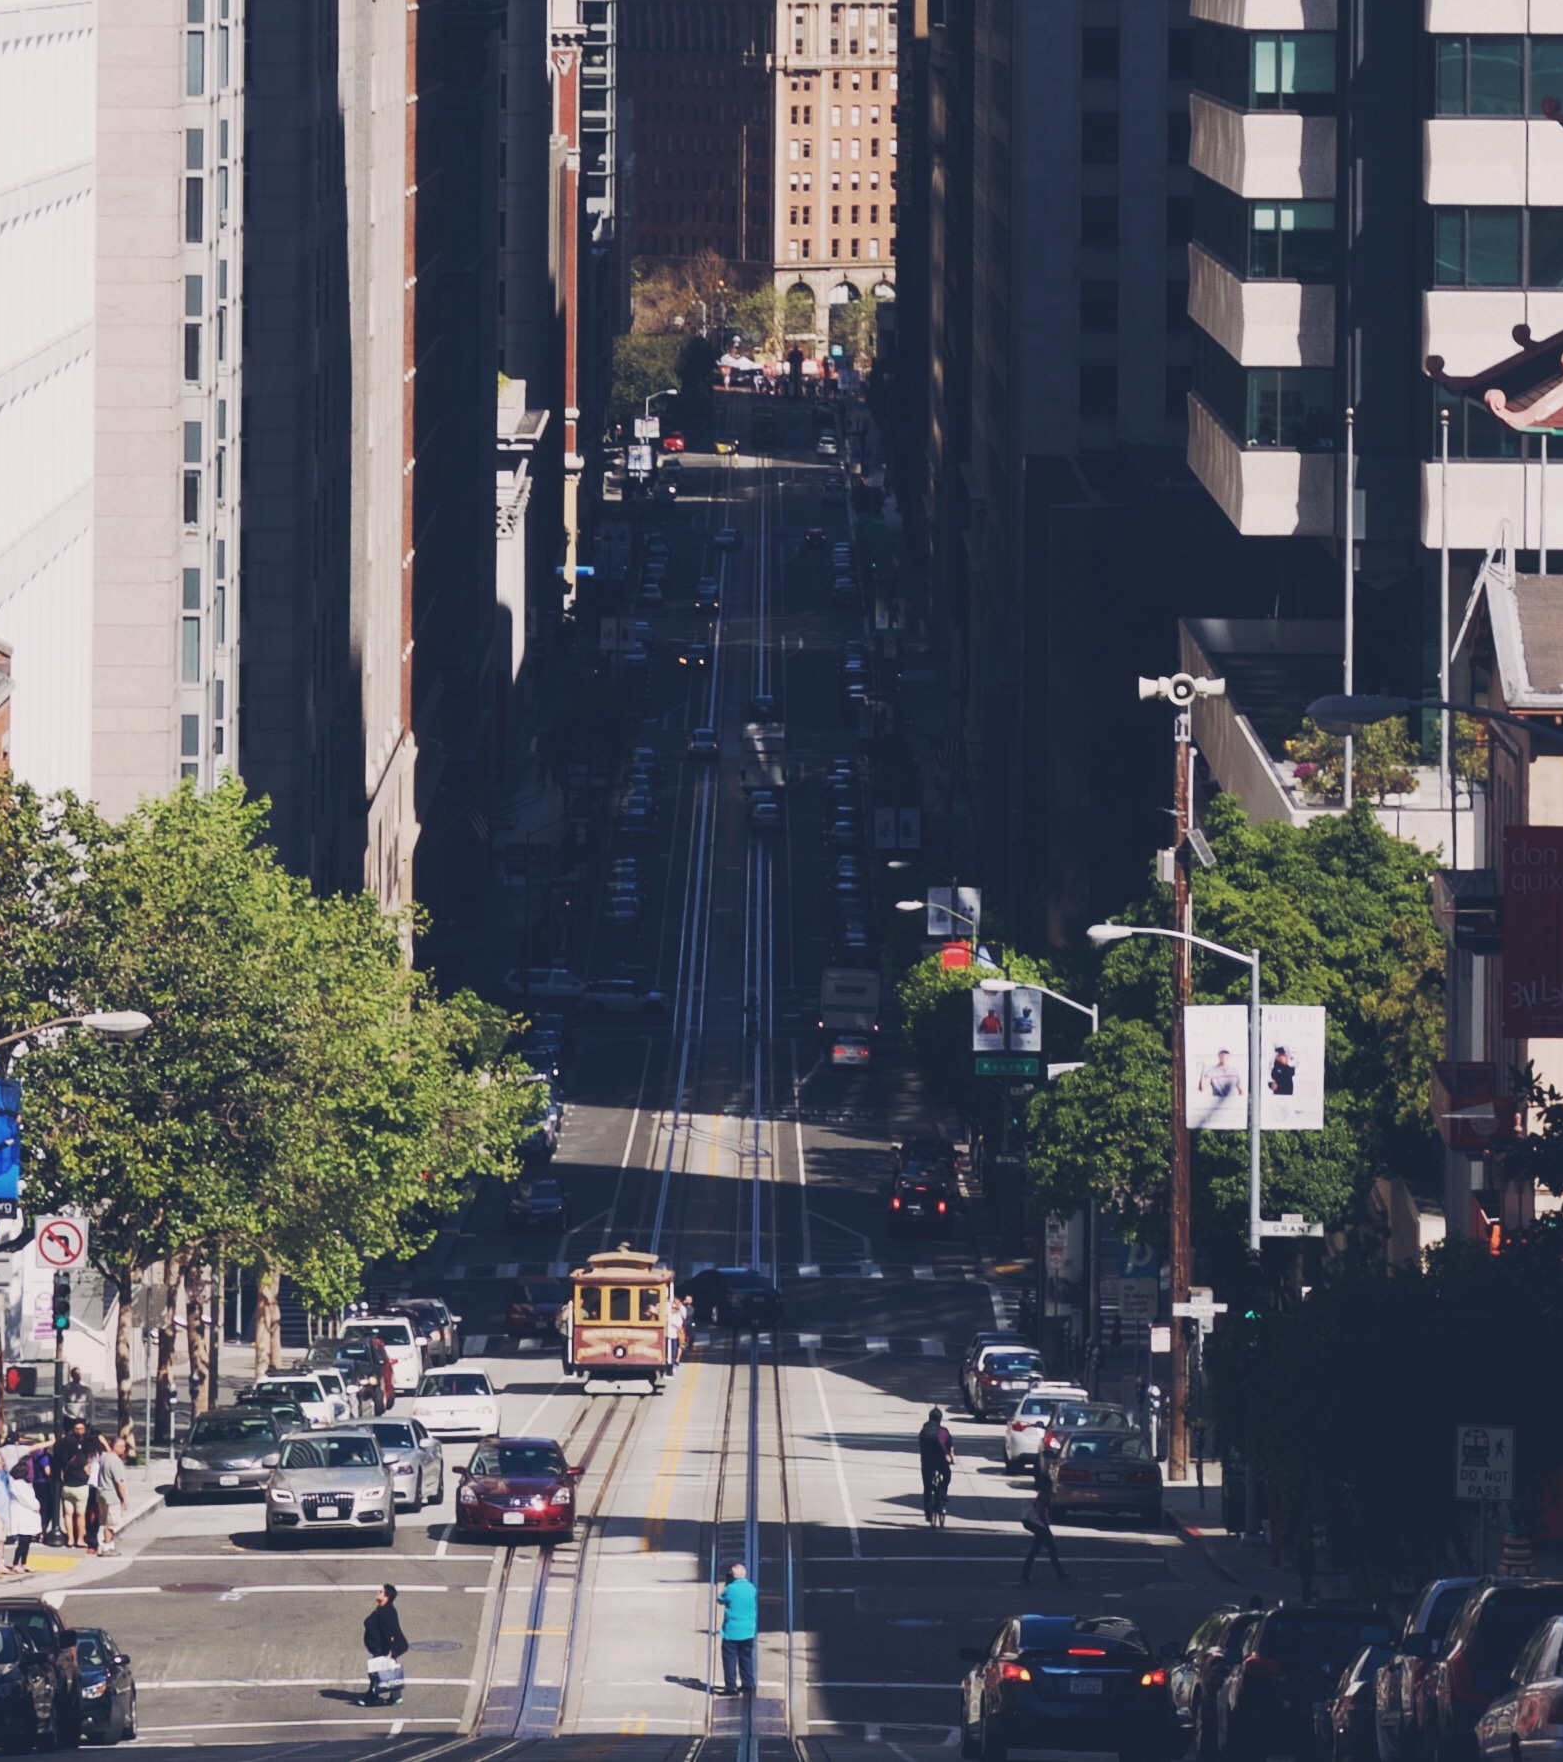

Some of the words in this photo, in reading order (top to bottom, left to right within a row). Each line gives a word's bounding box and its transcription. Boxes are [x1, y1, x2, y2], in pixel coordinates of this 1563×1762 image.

[1511, 841, 1558, 866] don
[1273, 1225, 1313, 1234] GRANT
[1460, 1469, 1477, 1481] DO
[1484, 1470, 1509, 1482] NOT
[1468, 1484, 1502, 1498] PASS
